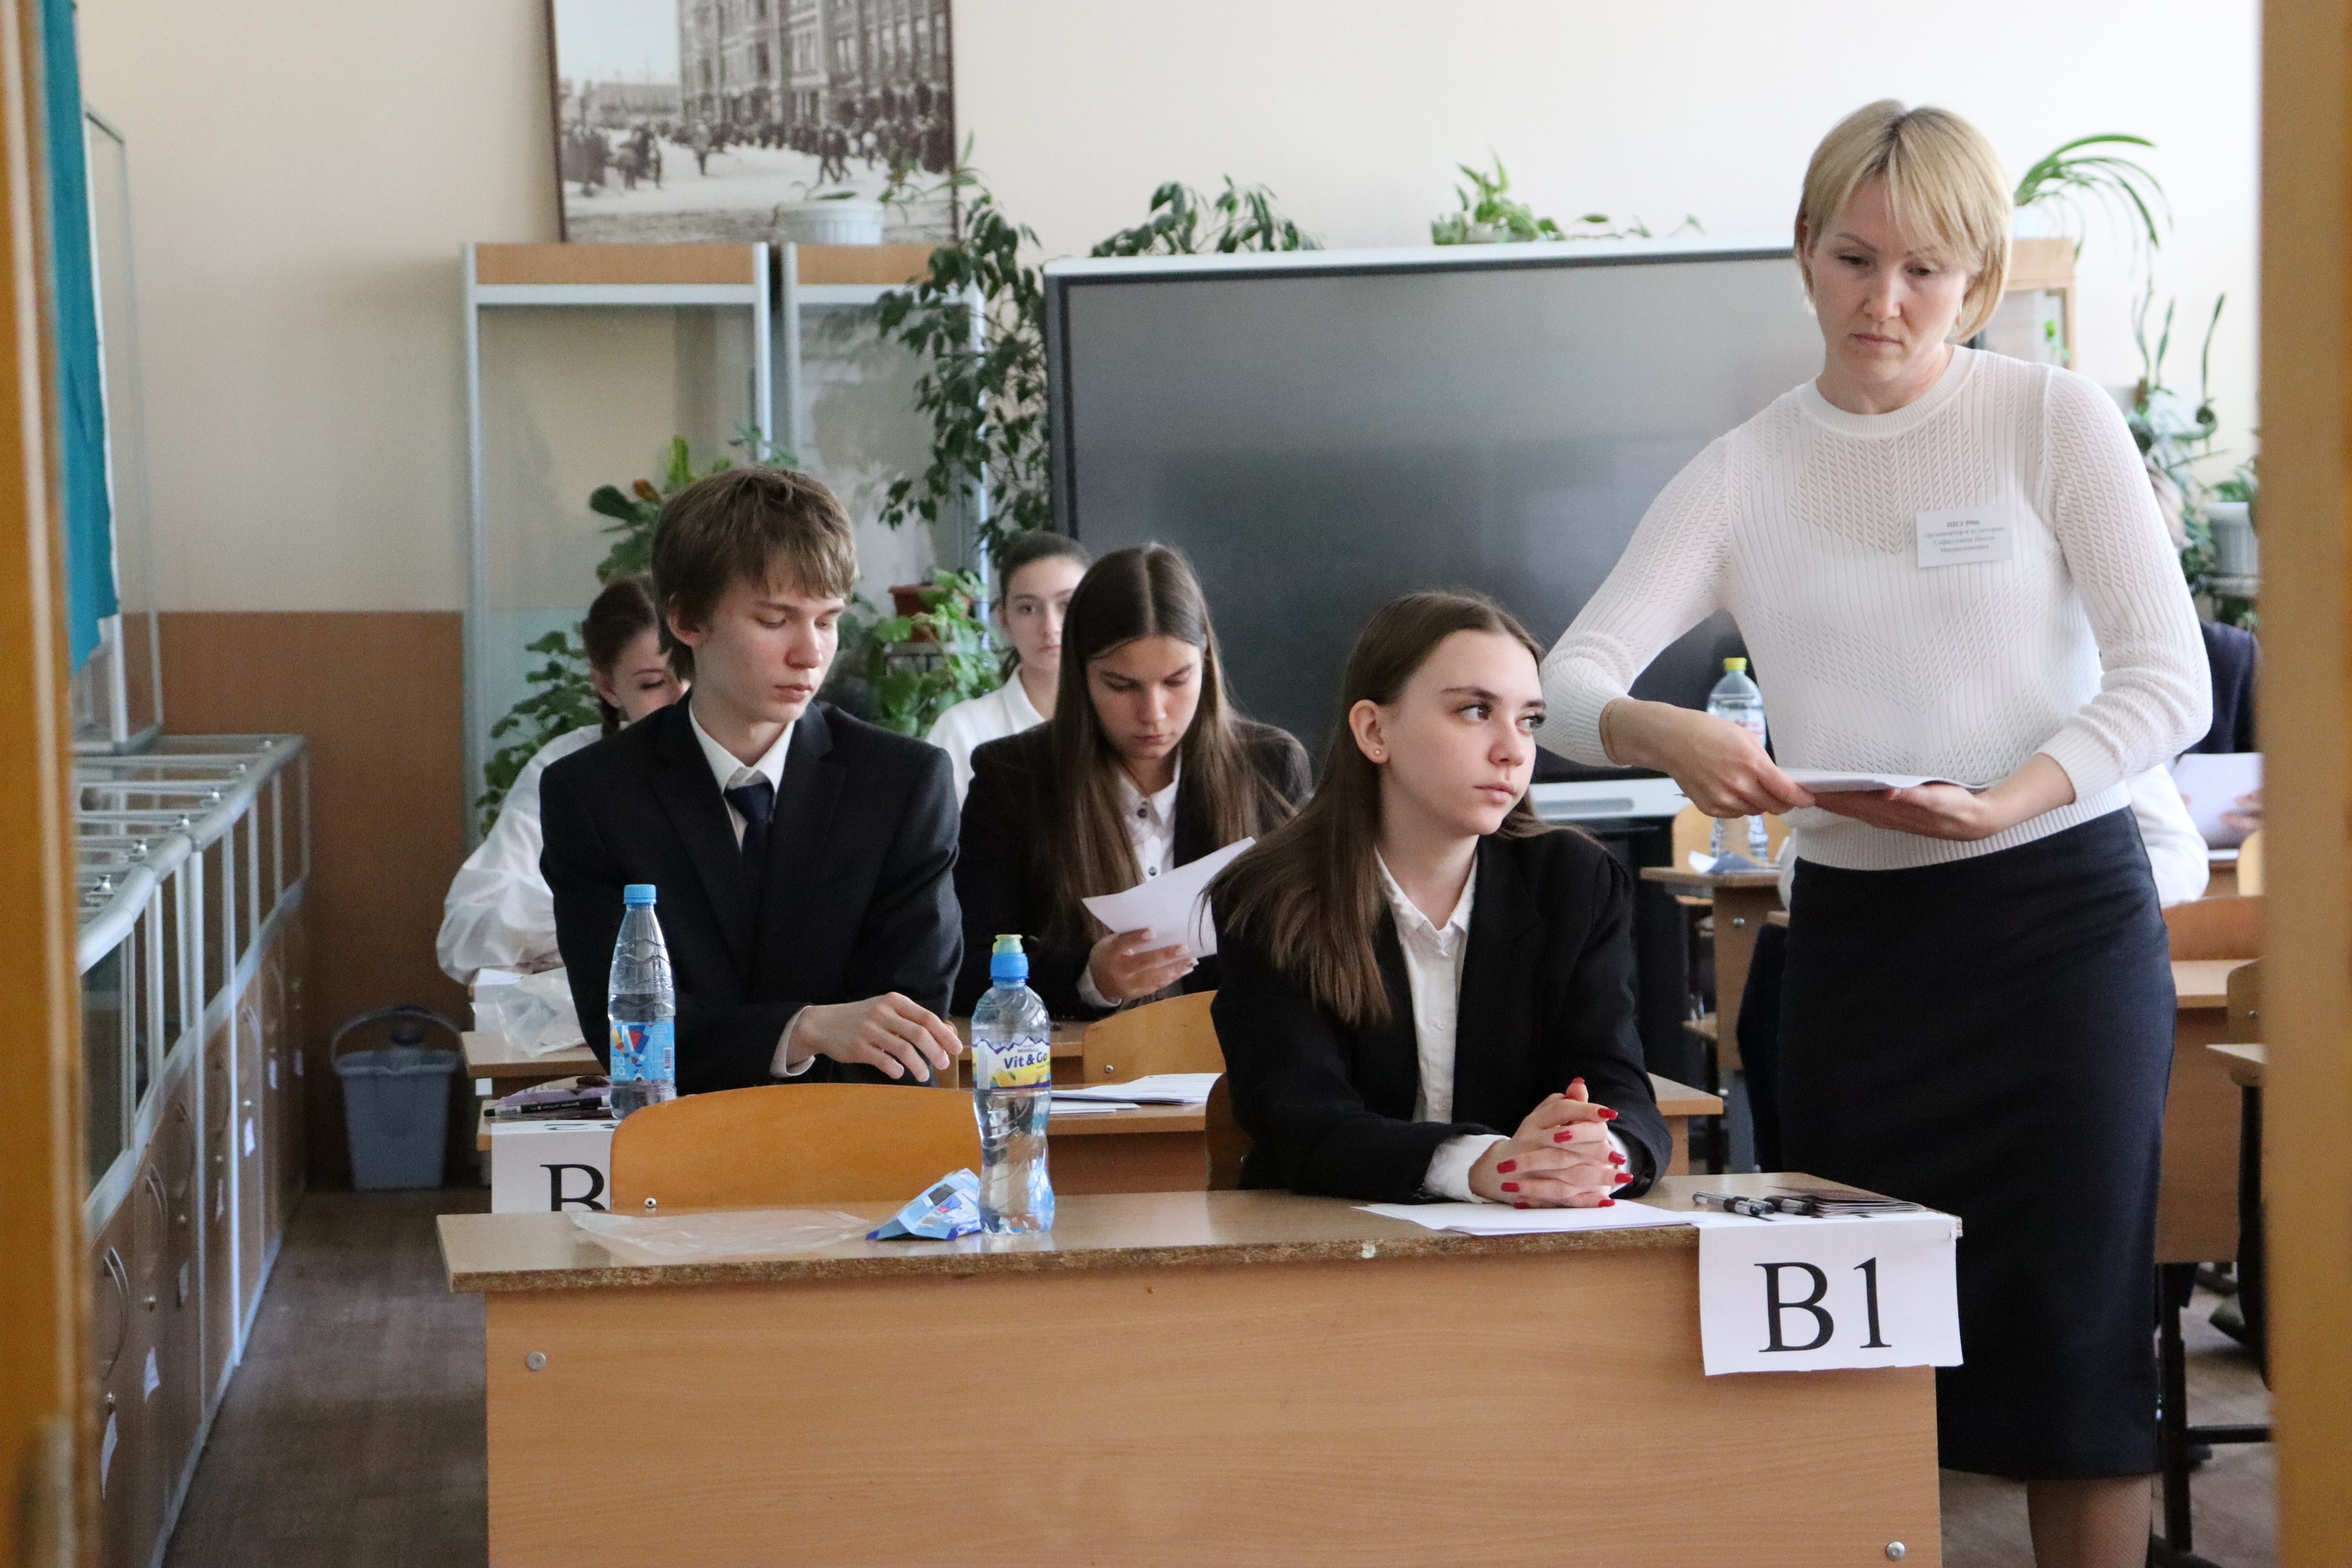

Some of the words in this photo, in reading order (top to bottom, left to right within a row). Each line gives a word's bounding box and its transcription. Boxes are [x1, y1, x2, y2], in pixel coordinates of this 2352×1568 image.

[1004, 1055, 1024, 1069] Vit
[1026, 1053, 1034, 1066] &
[1037, 1051, 1048, 1063] Go
